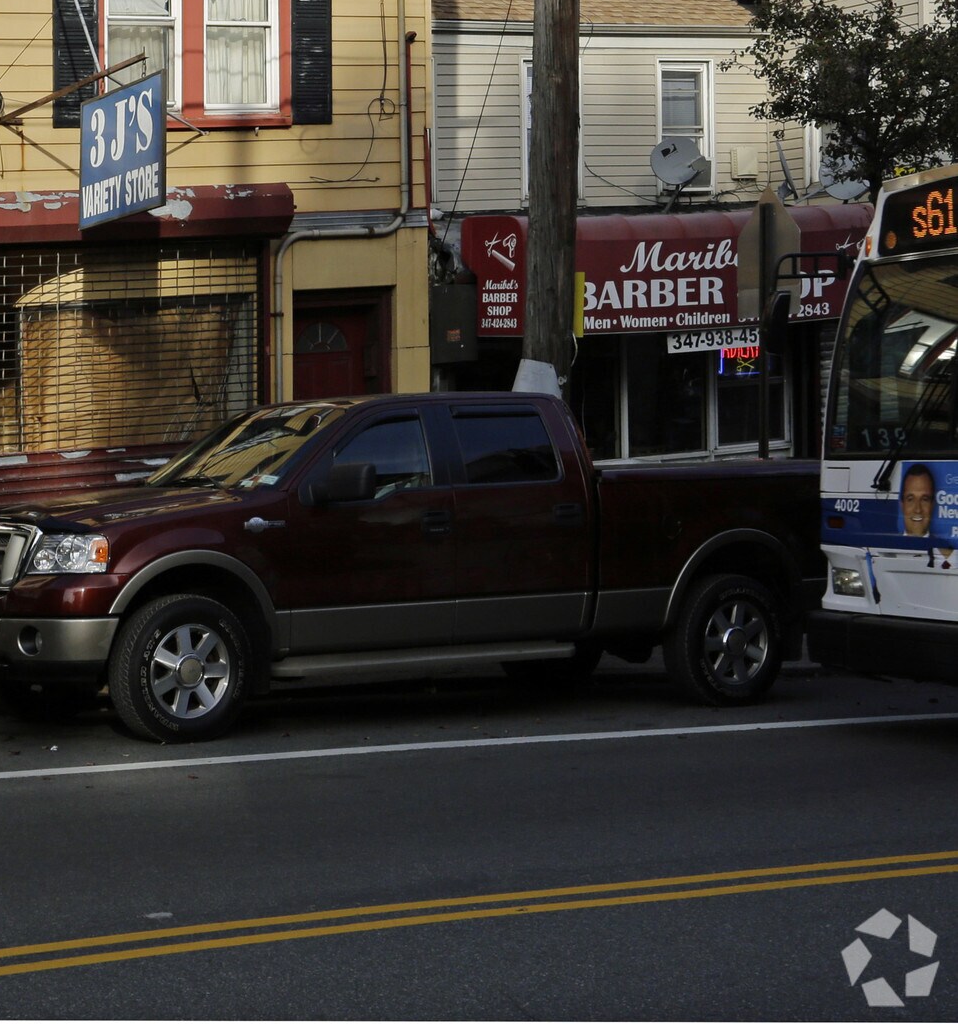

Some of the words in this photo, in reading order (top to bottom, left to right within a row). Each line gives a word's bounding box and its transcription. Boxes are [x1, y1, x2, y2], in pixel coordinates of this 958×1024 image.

[82, 174, 122, 219] VARIETY
[125, 162, 159, 206] STORE
[619, 238, 738, 273] Marib
[482, 279, 519, 291] Maribel's
[482, 292, 518, 304] BARBER
[487, 305, 512, 317] SHOP
[481, 317, 518, 329] 347-424-2843
[583, 316, 611, 330] Men
[620, 314, 667, 329] Women
[675, 312, 730, 326] Children
[672, 327, 759, 350] 347-938-45
[834, 499, 860, 513] 4002
